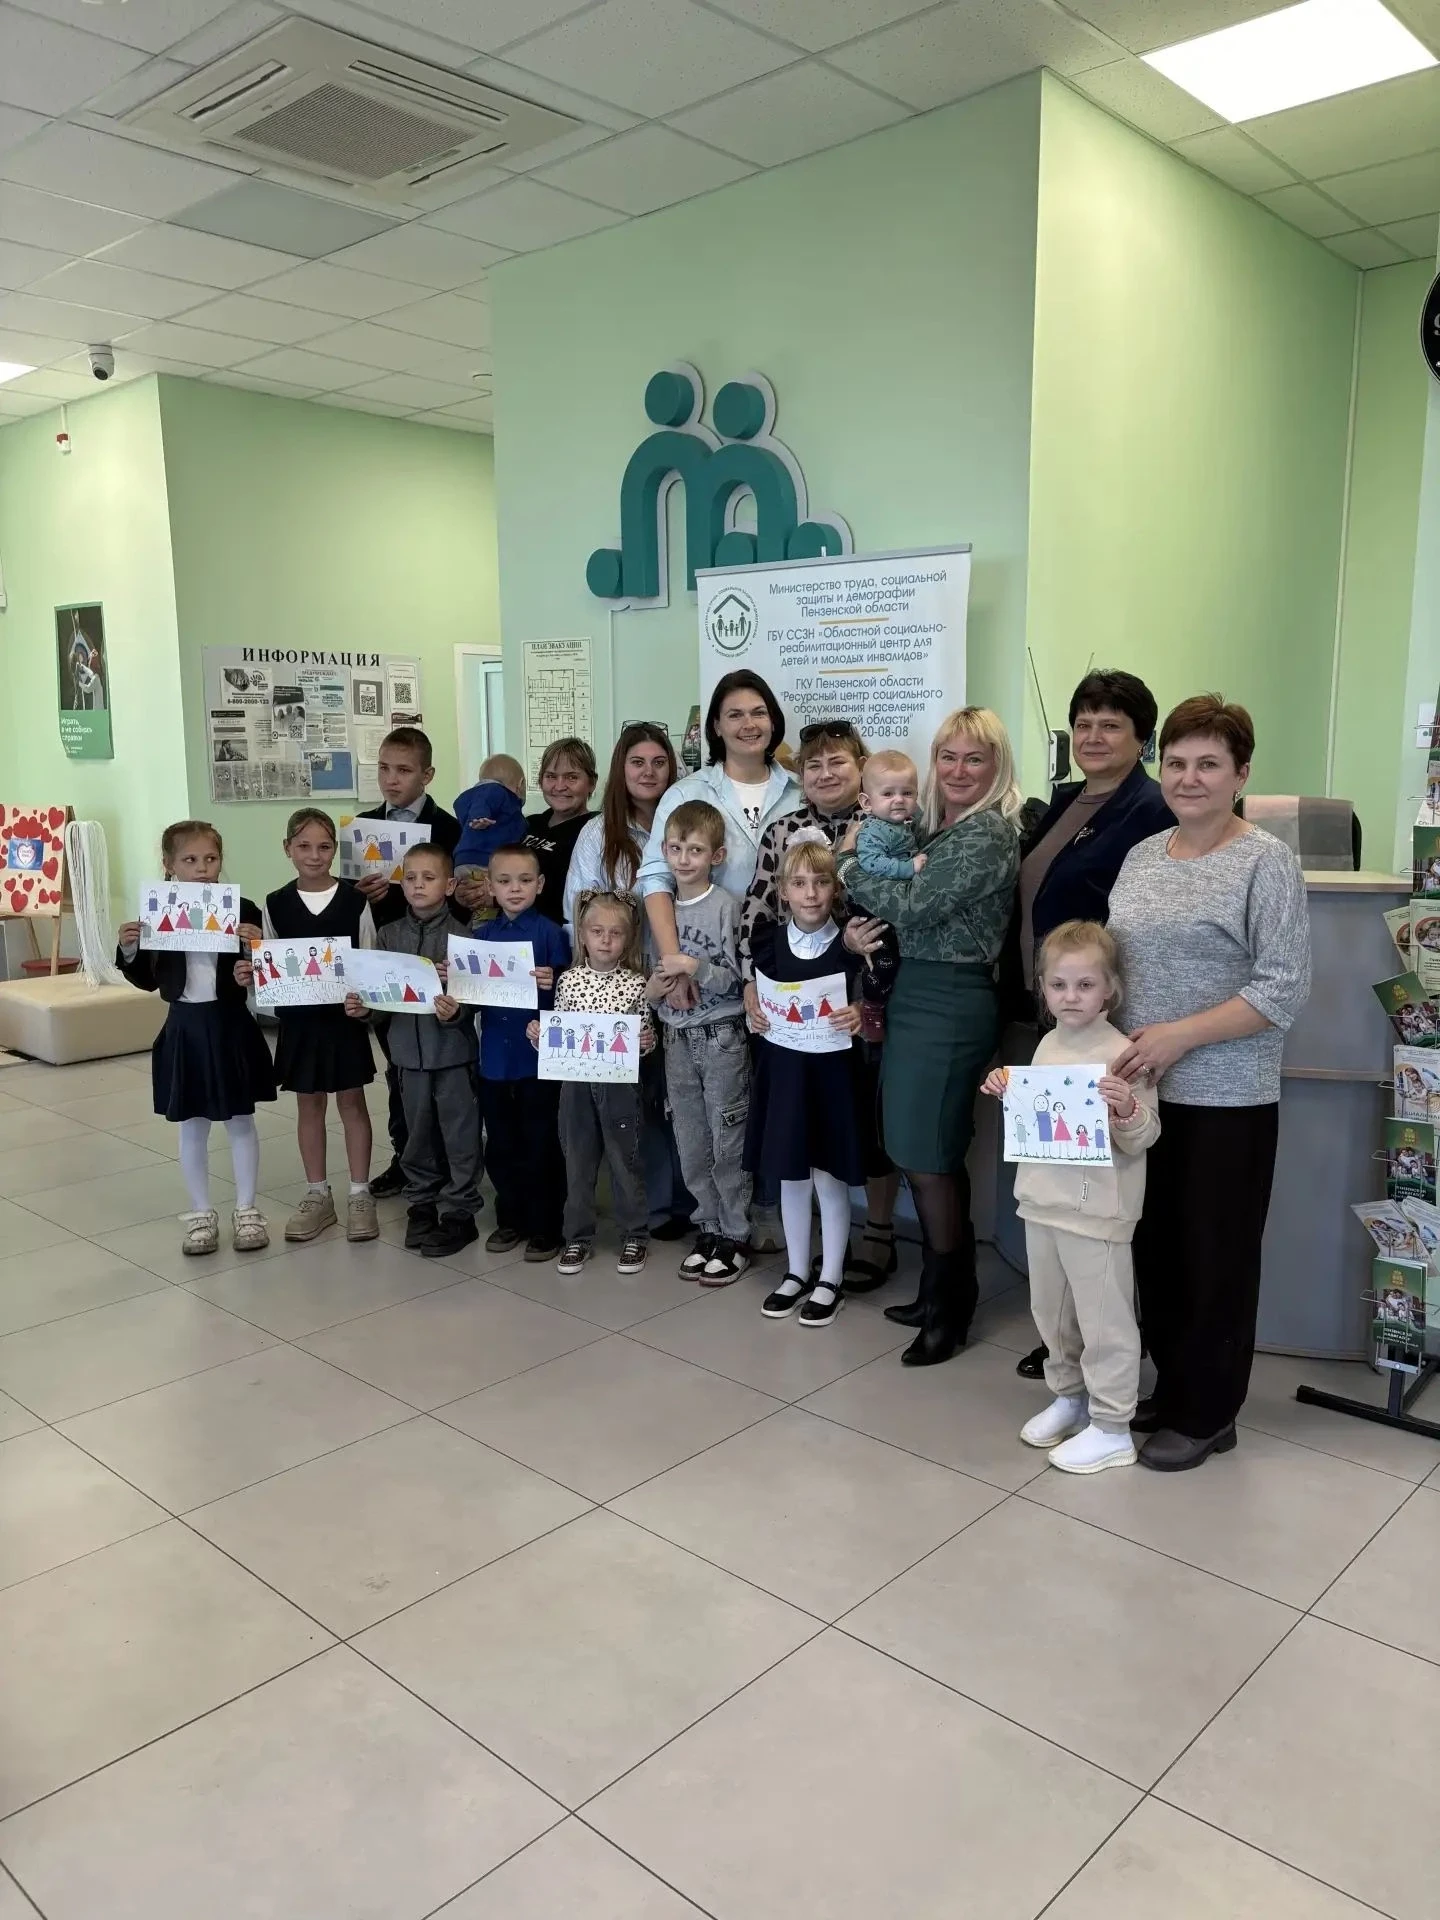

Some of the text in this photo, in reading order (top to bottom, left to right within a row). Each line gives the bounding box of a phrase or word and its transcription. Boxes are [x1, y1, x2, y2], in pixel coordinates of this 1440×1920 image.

[769, 570, 947, 596] Министерство труда, социальной
[796, 586, 916, 606] защиты и демографии
[801, 600, 909, 618] Пензенской области
[767, 629, 784, 642] ГБУ
[786, 628, 815, 641] ССЗН
[883, 622, 947, 636] социально-
[779, 637, 932, 656] реабилитационный центр для
[242, 647, 380, 668] ИНФОРМАЦИЯ
[780, 650, 928, 667] детей и молодых инвалидов»
[796, 674, 924, 690] ГКУ Пензенской области
[840, 690, 870, 703] центр
[872, 688, 943, 701] социального
[793, 701, 925, 715] обслуживания населения
[866, 712, 914, 725] области"
[861, 725, 909, 738] 20-08-08
